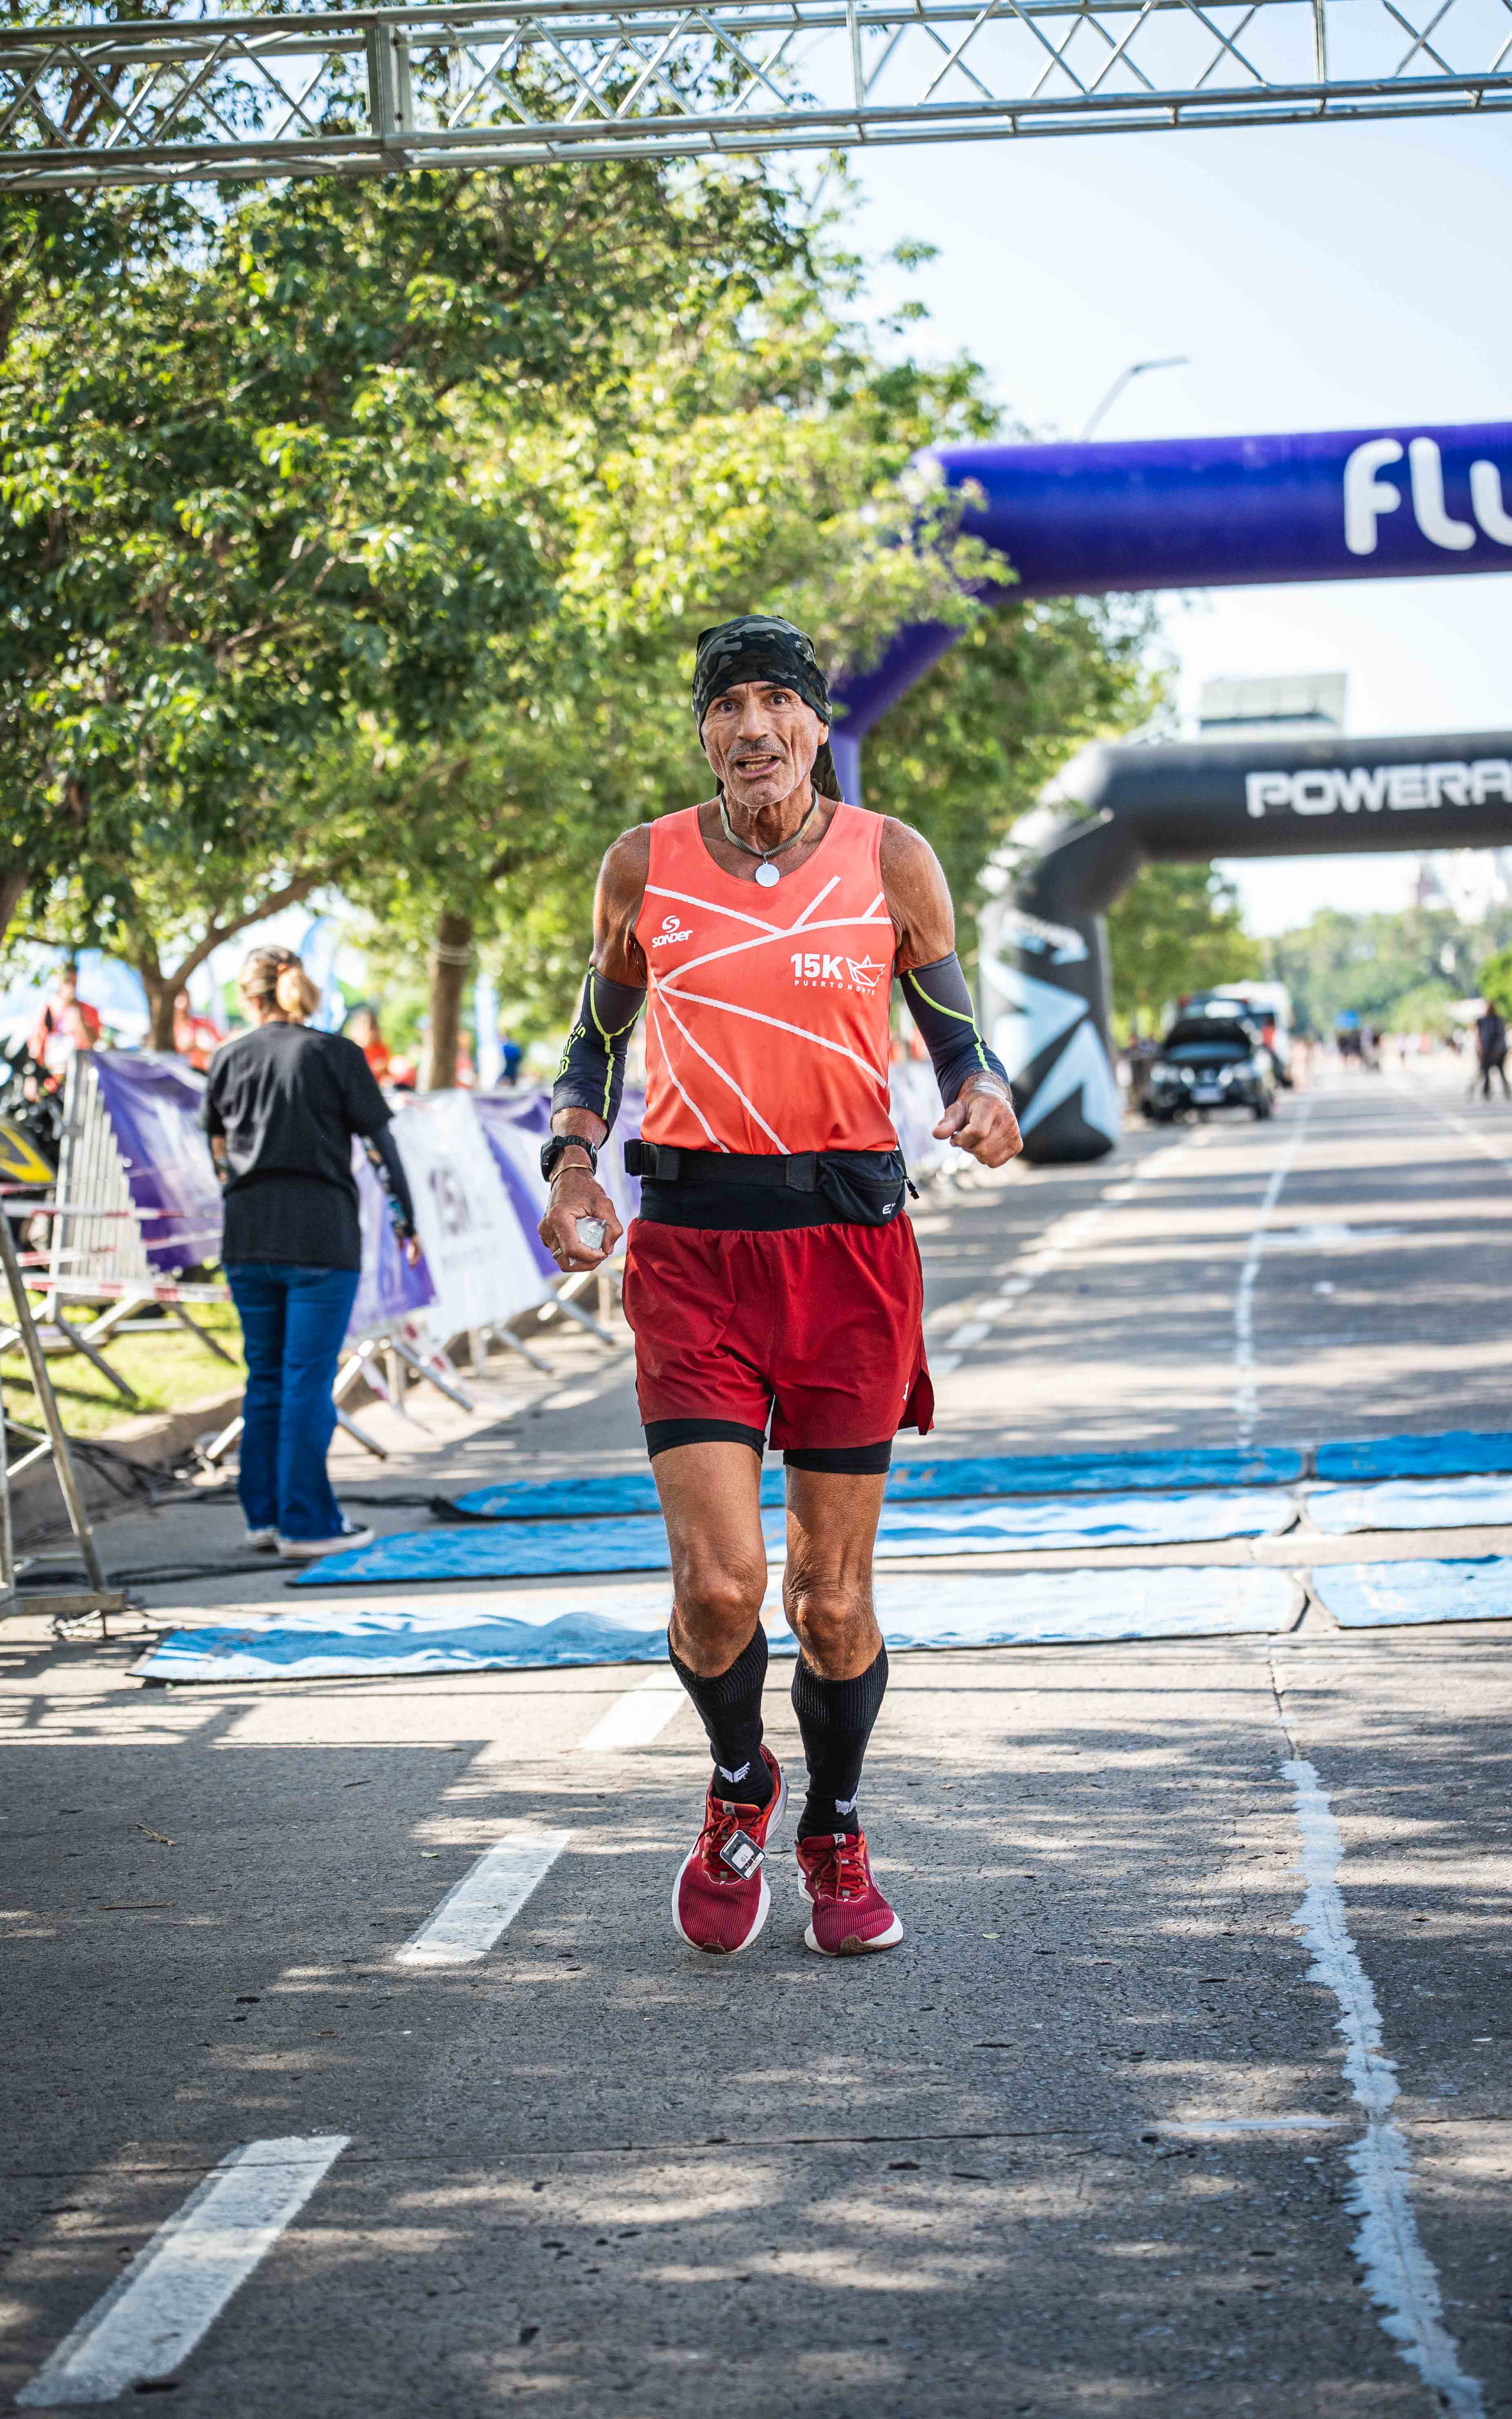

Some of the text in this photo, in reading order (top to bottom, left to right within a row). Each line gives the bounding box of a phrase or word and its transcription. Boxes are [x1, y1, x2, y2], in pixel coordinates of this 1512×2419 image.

[790, 953, 844, 980] 15K
[794, 980, 875, 996] PUERTO NORTE
